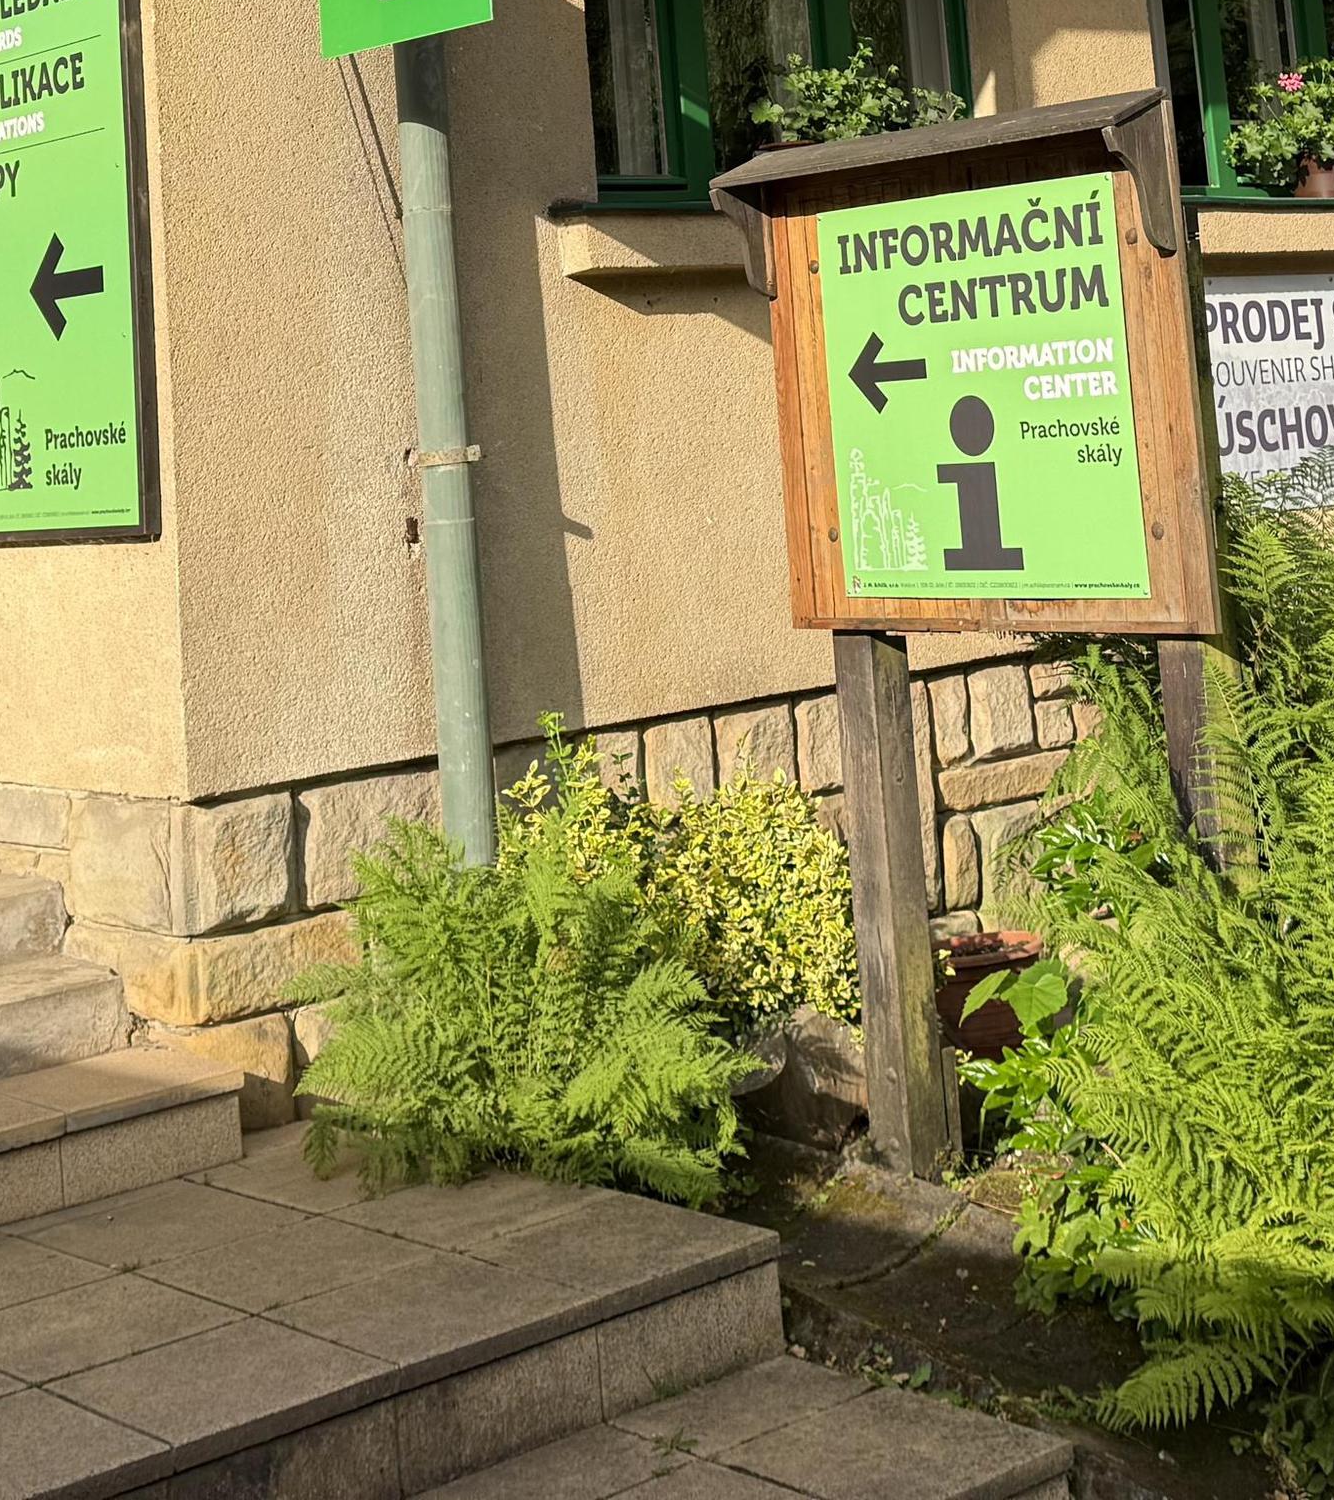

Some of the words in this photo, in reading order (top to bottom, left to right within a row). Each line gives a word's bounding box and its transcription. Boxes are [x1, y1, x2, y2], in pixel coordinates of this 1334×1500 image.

[837, 190, 1104, 276] INFORMAČNÍ
[897, 264, 1110, 326] CENTRUM
[951, 337, 1114, 374] INFORMATION
[1023, 370, 1118, 402] CENTER
[1212, 357, 1307, 388] OUVENIR
[44, 420, 127, 451] Prachovské
[1019, 415, 1120, 440] Prachovské
[1076, 443, 1123, 468] skály
[45, 463, 82, 490] skály
